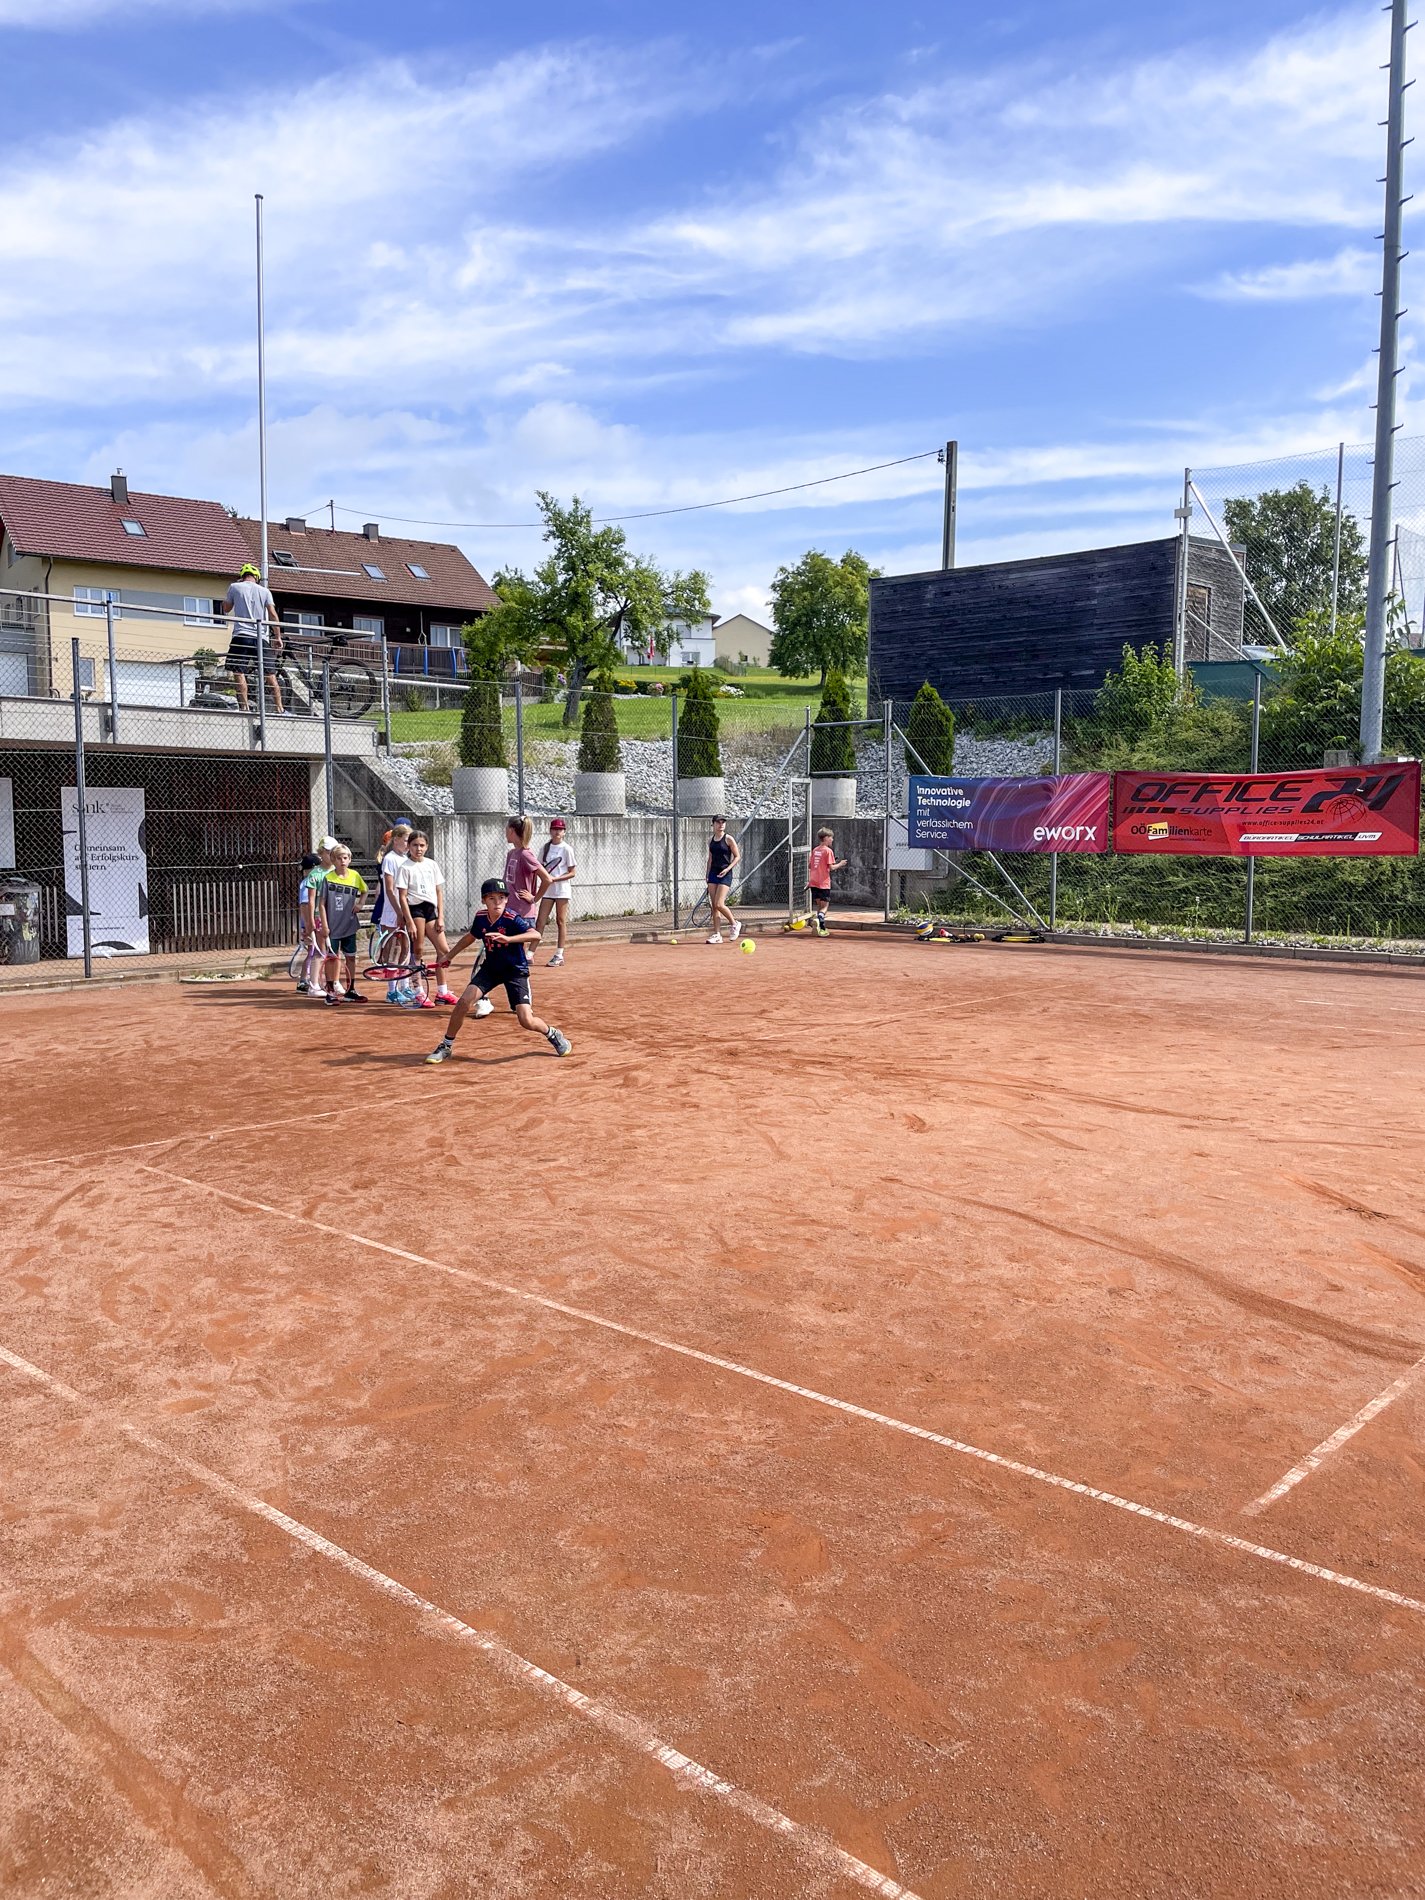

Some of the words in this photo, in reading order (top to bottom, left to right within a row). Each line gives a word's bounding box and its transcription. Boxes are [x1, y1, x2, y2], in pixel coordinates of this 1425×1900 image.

[916, 785, 964, 796] Innovative
[1130, 779, 1317, 803] OFFICE
[1301, 774, 1406, 814] 24
[916, 796, 972, 808] Technologie
[916, 808, 931, 817] mit
[1179, 805, 1296, 815] SUPPLIES
[916, 818, 974, 830] verlässlichem
[915, 829, 950, 840] Service.
[1033, 825, 1098, 842] eworx
[74, 843, 126, 852] Gmeinsam
[91, 853, 140, 863] Erfolgskurs
